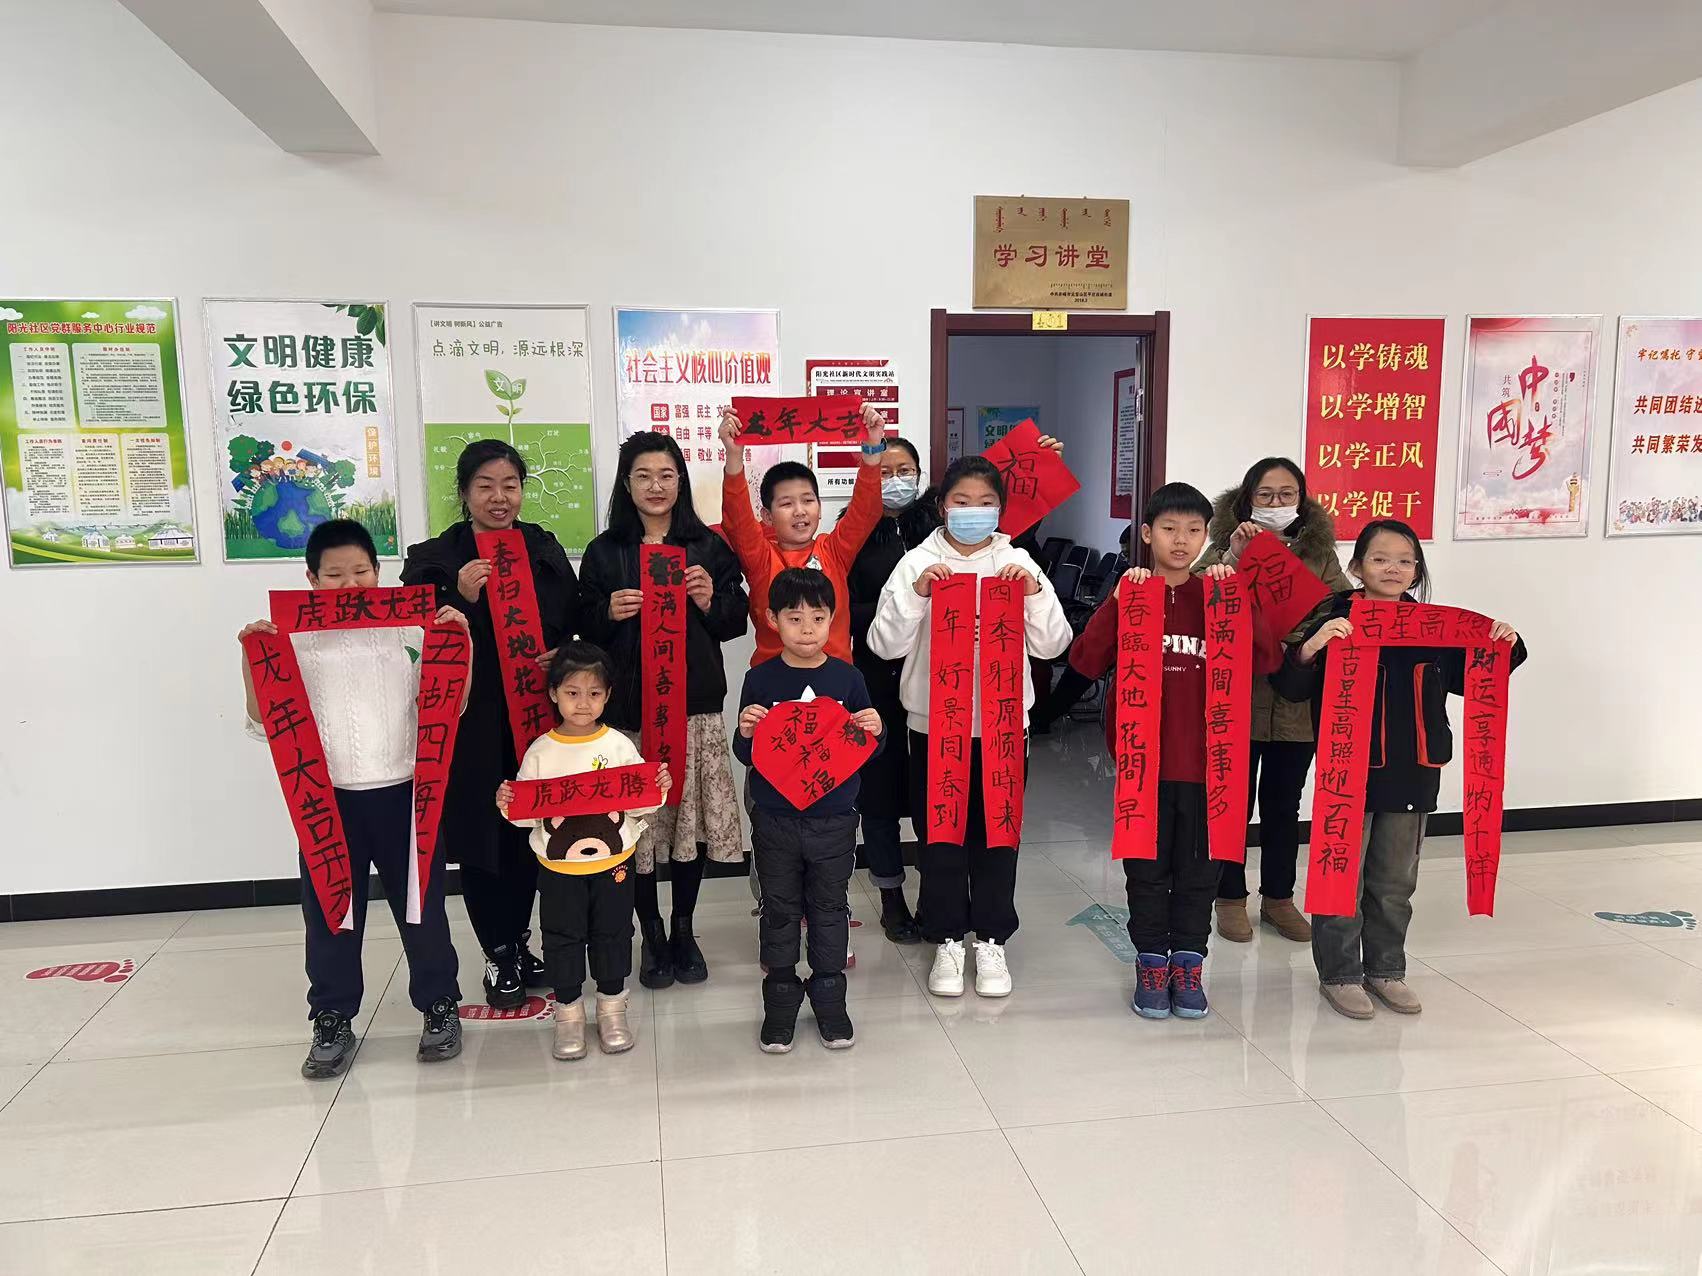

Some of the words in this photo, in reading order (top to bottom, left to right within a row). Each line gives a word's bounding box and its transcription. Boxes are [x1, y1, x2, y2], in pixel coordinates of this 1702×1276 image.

[993, 243, 1111, 269] 学习讲堂
[7, 322, 157, 335] 阳光社区党群服务中心行业规范
[223, 333, 375, 369] 文明健康
[1321, 342, 1430, 372] 以学铸魂
[1637, 347, 1681, 361] 牢记嘱托
[625, 350, 772, 385] 社会主义核心价值观
[815, 370, 895, 378] 阳光社区新时代文明实践站
[227, 379, 378, 415] 绿色环保
[494, 377, 523, 395] 文明
[1501, 374, 1512, 398] 共筑
[653, 405, 668, 419] 国家
[674, 404, 690, 418] 富强
[696, 404, 712, 419] 民主
[1320, 392, 1427, 421] 以学增智
[675, 426, 690, 440] 自由
[697, 426, 712, 440] 平等
[697, 447, 713, 461] 敬业
[1317, 441, 1425, 470] 以学正风
[997, 447, 1040, 500] 福
[1317, 490, 1423, 519] 以学促干
[1243, 552, 1294, 609] 福
[1360, 601, 1489, 641] 吉星高照
[785, 704, 820, 735] 福
[934, 581, 970, 829] 一年好景同春到
[770, 724, 797, 753] 福
[794, 736, 831, 770] 福
[1316, 645, 1361, 878] 吉星高照迎百福
[531, 771, 649, 812] 虎跃龙腾
[801, 767, 836, 801] 福
